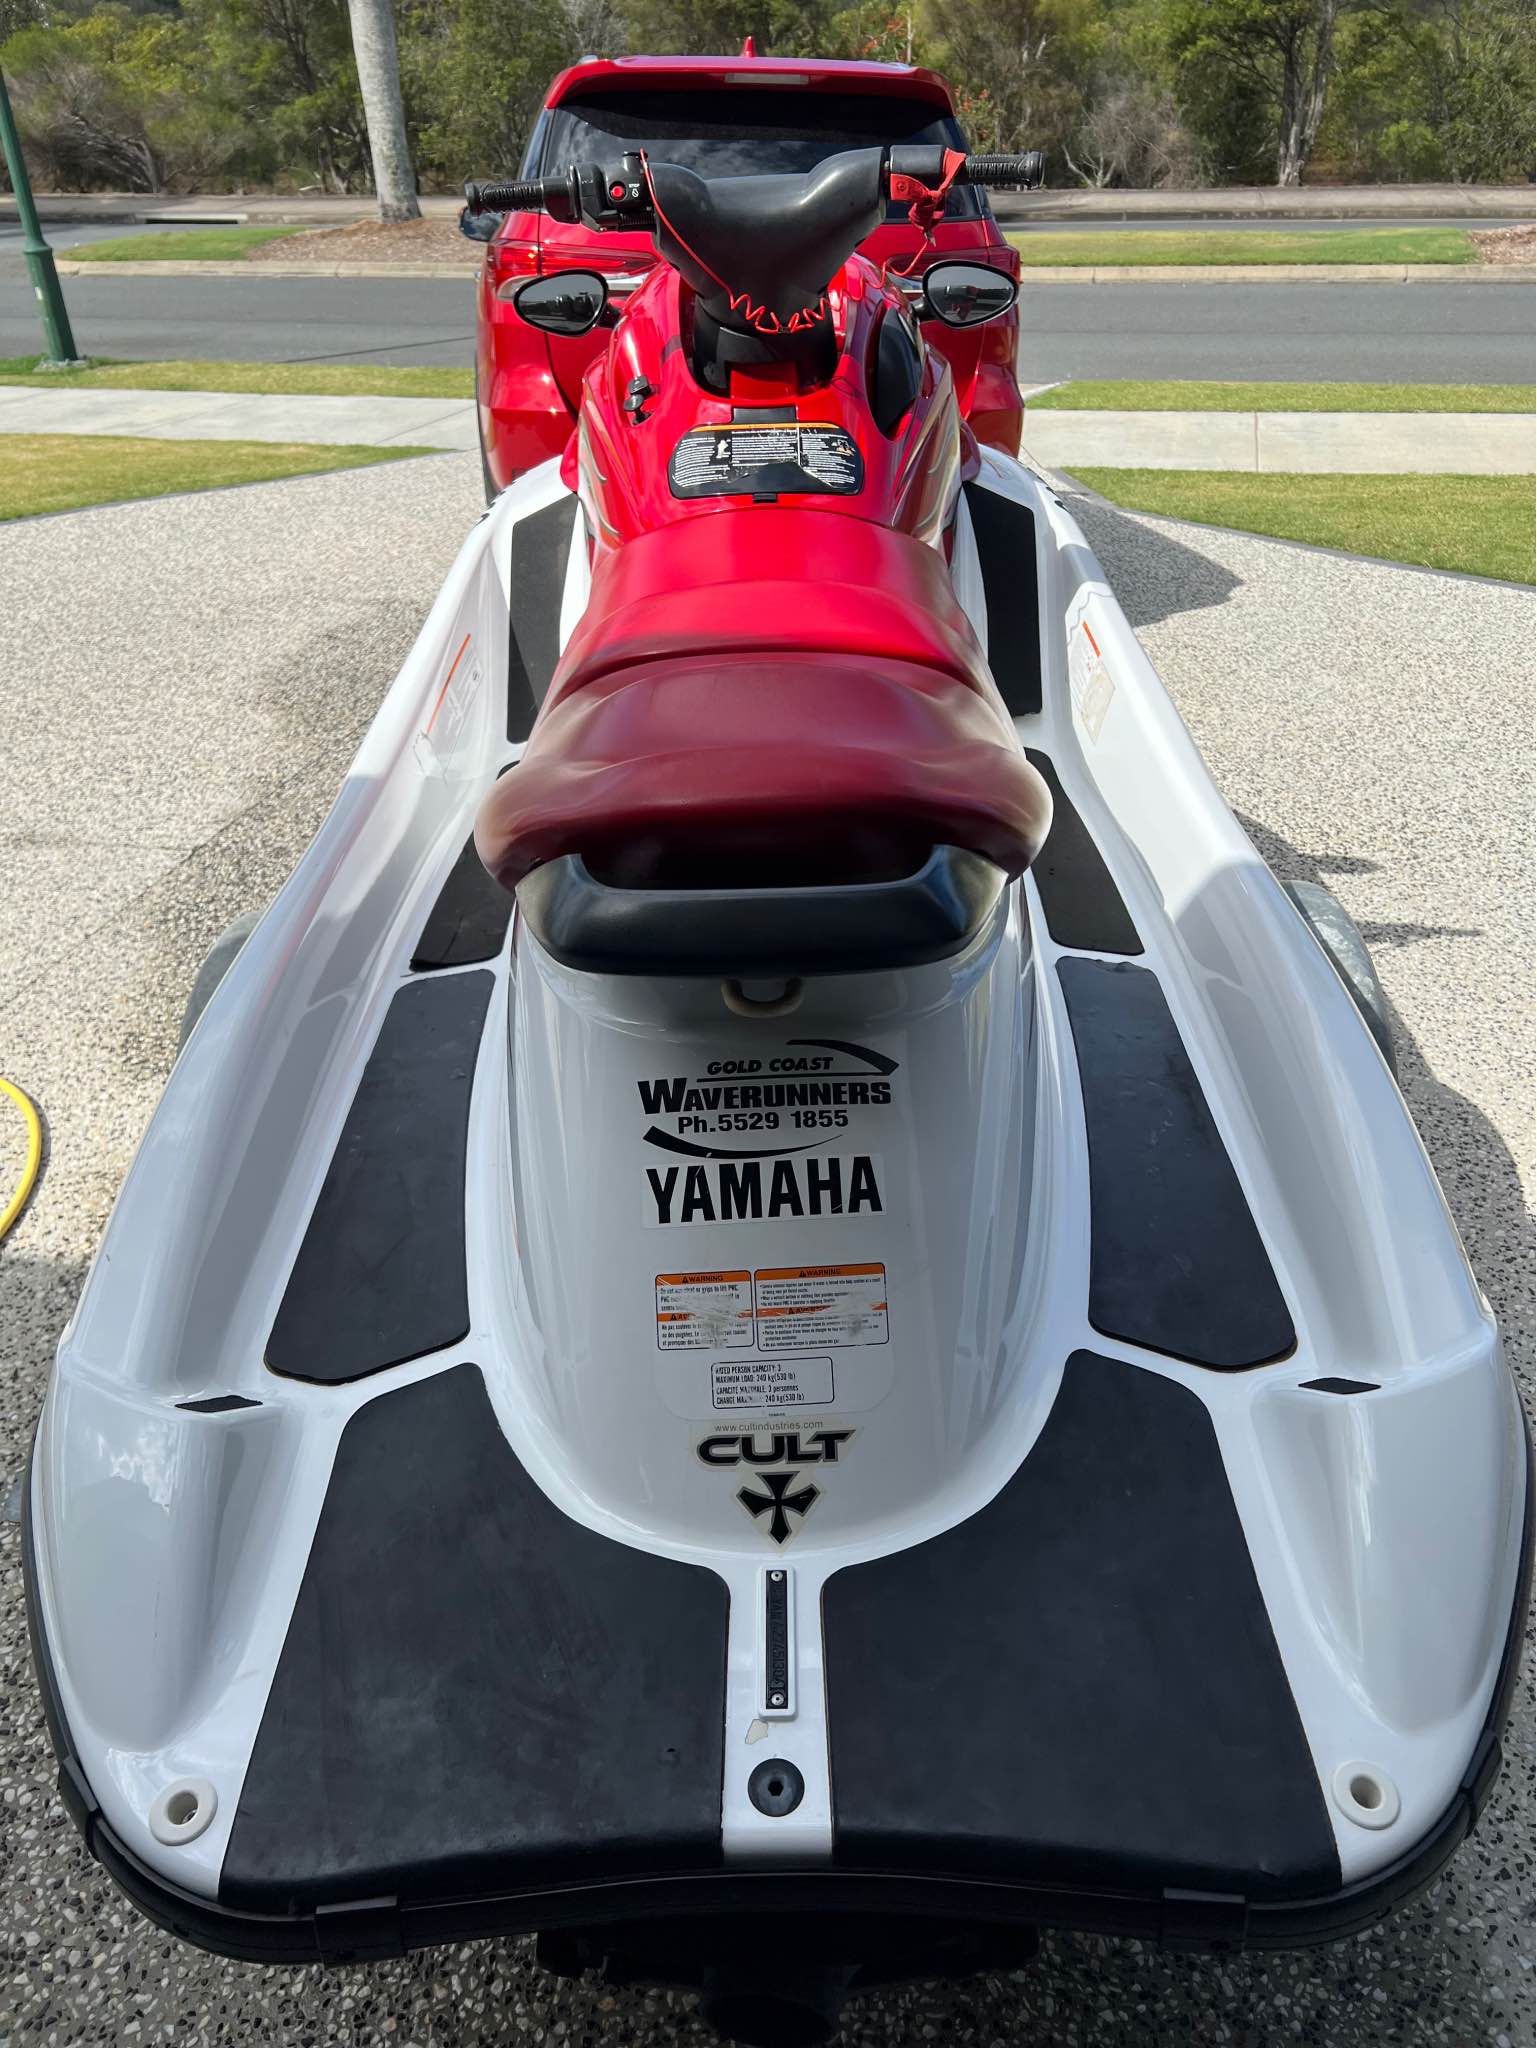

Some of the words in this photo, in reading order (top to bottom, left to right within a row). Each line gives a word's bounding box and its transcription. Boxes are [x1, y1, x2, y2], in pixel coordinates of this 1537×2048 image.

[707, 1059, 762, 1075] GOLD
[769, 1057, 834, 1072] COAST
[637, 1077, 892, 1115] WAVERUNNERS
[678, 1112, 779, 1134] Ph.5529
[790, 1109, 849, 1129] 1855
[646, 1156, 883, 1225] YAMAHA
[689, 1275, 724, 1283] WARNING
[806, 1268, 841, 1277] WARNING
[731, 1365, 751, 1374] PERSON
[716, 1375, 740, 1383] MAXIMUM
[714, 1421, 824, 1432] www.cultindustries.com
[697, 1429, 857, 1466] CULT
